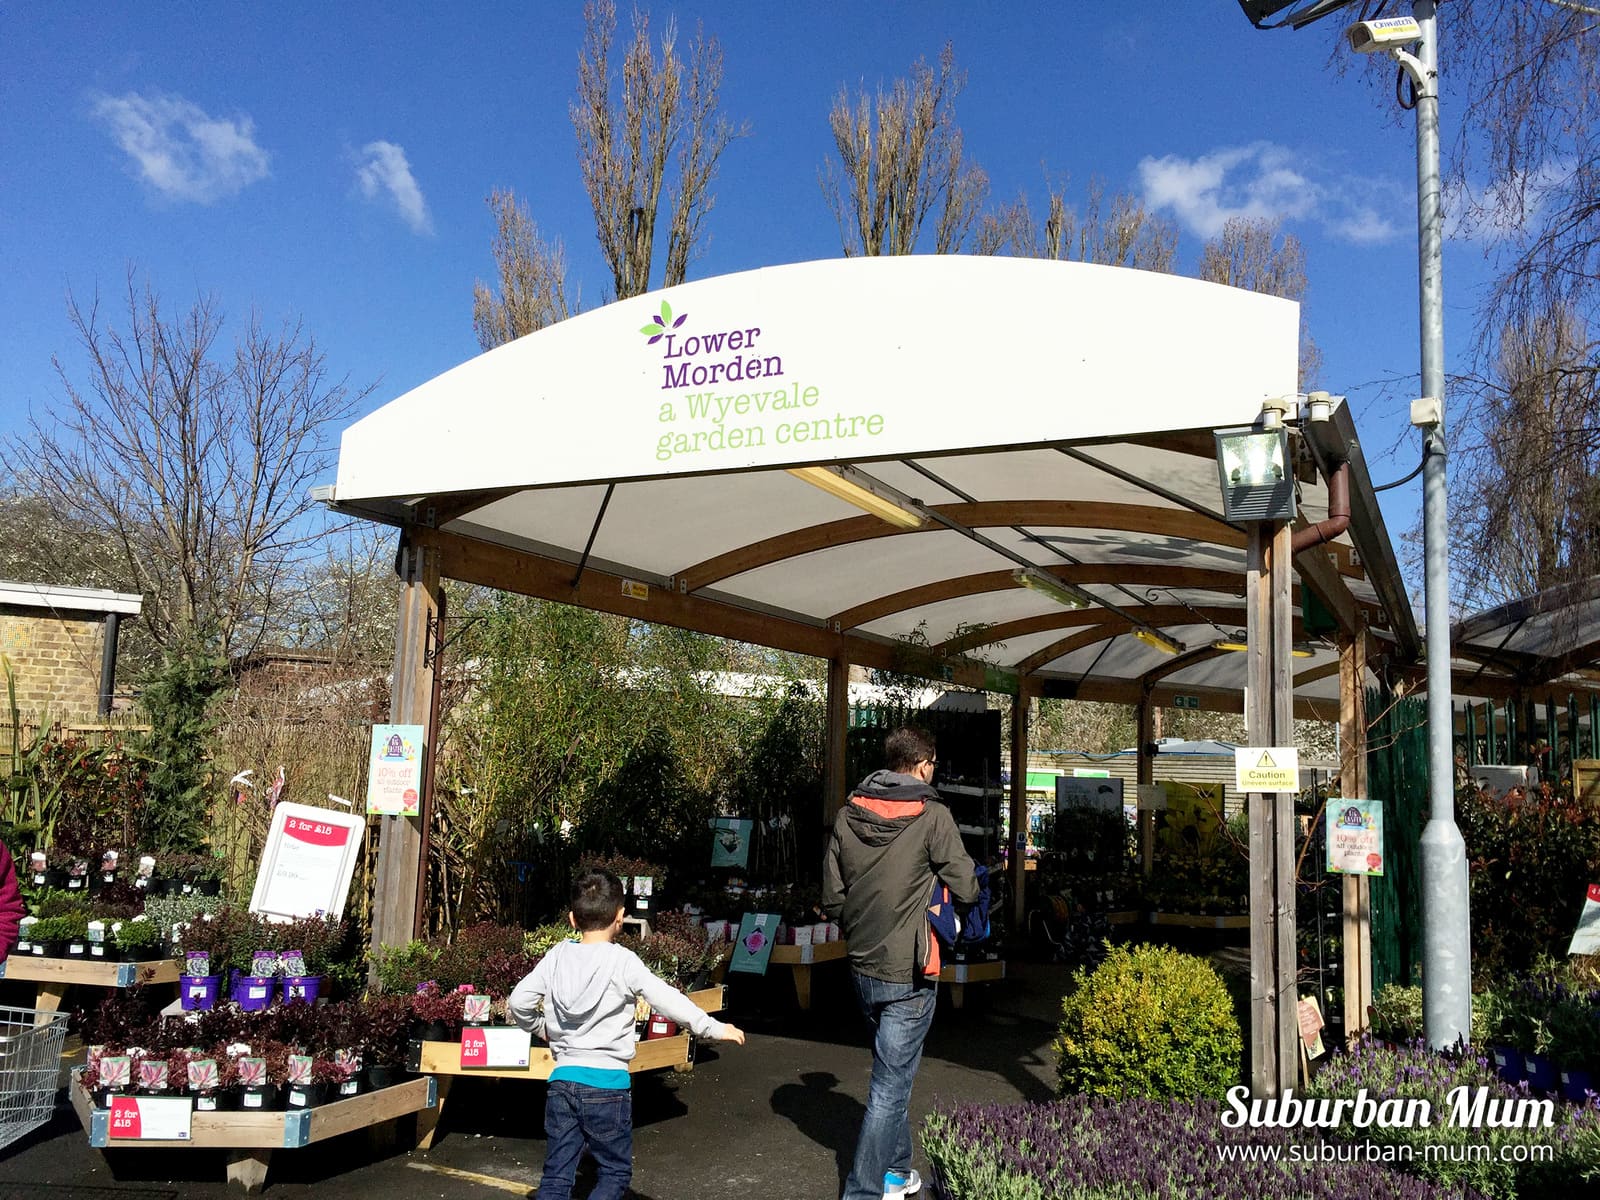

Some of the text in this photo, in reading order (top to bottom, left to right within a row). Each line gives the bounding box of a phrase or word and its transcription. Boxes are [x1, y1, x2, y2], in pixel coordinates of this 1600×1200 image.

[663, 327, 761, 359] Lower
[661, 354, 784, 389] Morden
[658, 382, 819, 424] a Wyevale
[656, 412, 884, 461] garden centre
[399, 768, 412, 778] off
[1248, 771, 1286, 779] Caution
[288, 819, 333, 836] 2 for £15
[464, 1040, 485, 1048] 2 for
[463, 1048, 480, 1057] £15
[114, 1109, 138, 1119] 2 for
[113, 1118, 131, 1128] £15
